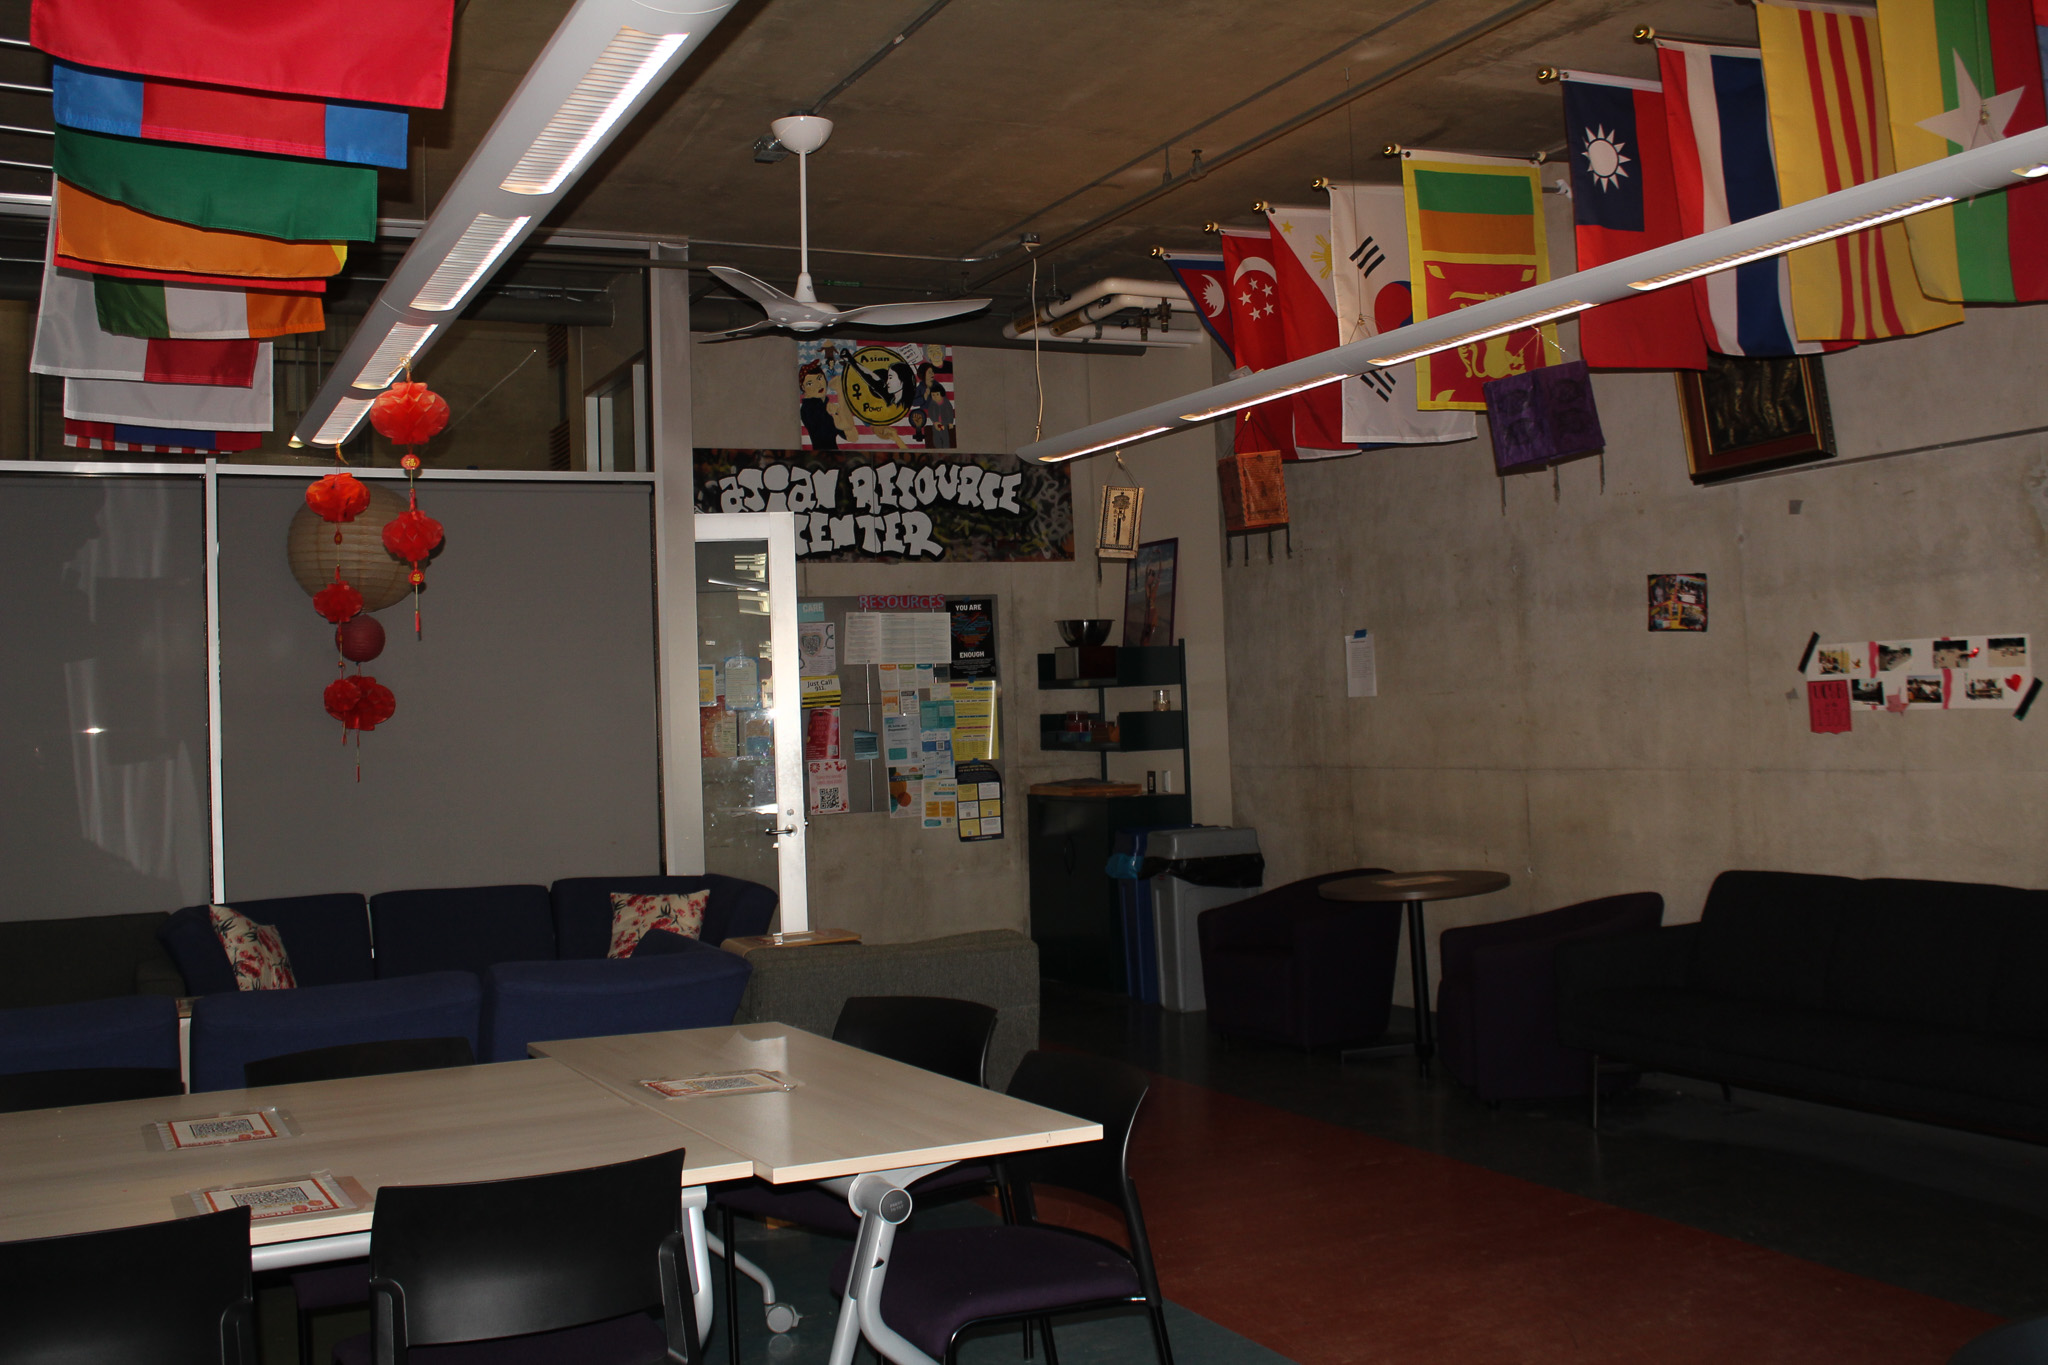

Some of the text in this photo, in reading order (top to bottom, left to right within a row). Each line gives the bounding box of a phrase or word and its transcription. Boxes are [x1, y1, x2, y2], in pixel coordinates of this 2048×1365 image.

[860, 355, 891, 364] Asian
[848, 461, 1022, 514] RESOURCE
[859, 595, 945, 609] RESOURCES
[802, 603, 824, 613] CARE
[959, 651, 985, 659] ENOUGH
[807, 680, 820, 688] Just
